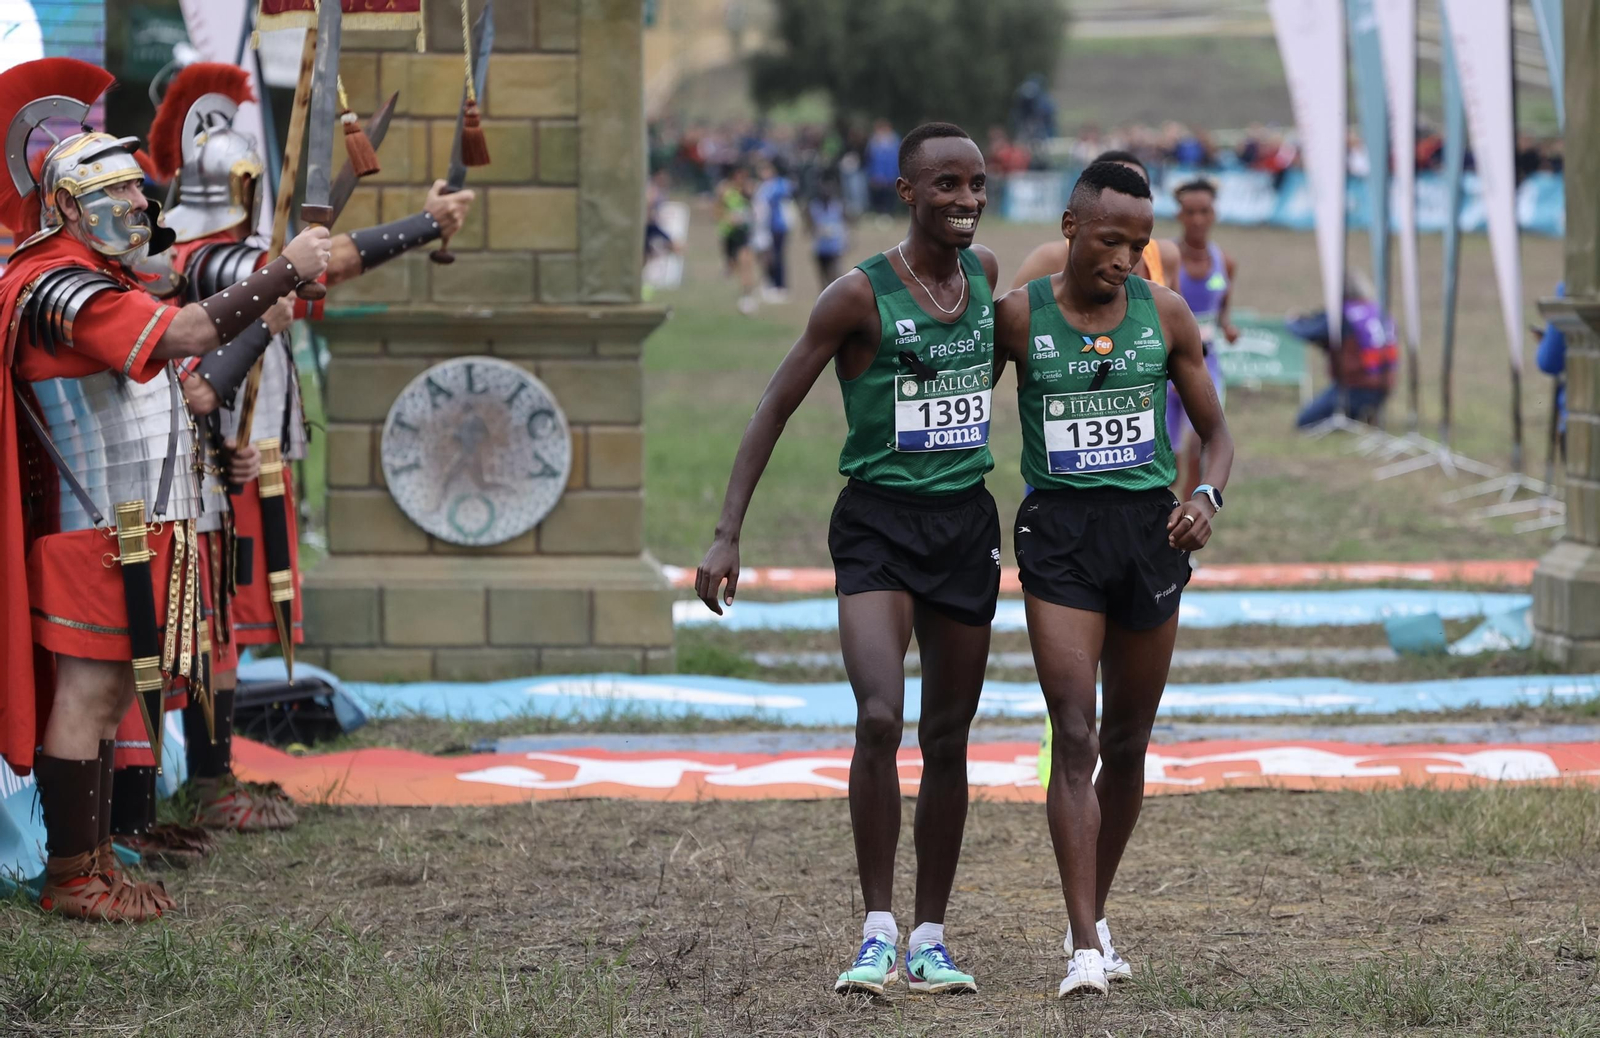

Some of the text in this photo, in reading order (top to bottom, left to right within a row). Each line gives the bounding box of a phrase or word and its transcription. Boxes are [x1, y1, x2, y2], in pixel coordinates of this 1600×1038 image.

[895, 335, 922, 345] rasán
[929, 338, 975, 359] Facsa
[1096, 340, 1111, 349] Fer
[1033, 350, 1060, 359] rasán
[924, 374, 980, 394] ITÁLICA
[918, 395, 984, 428] 1393
[1070, 395, 1137, 414] ITÁLICA
[1066, 416, 1141, 448] 1395
